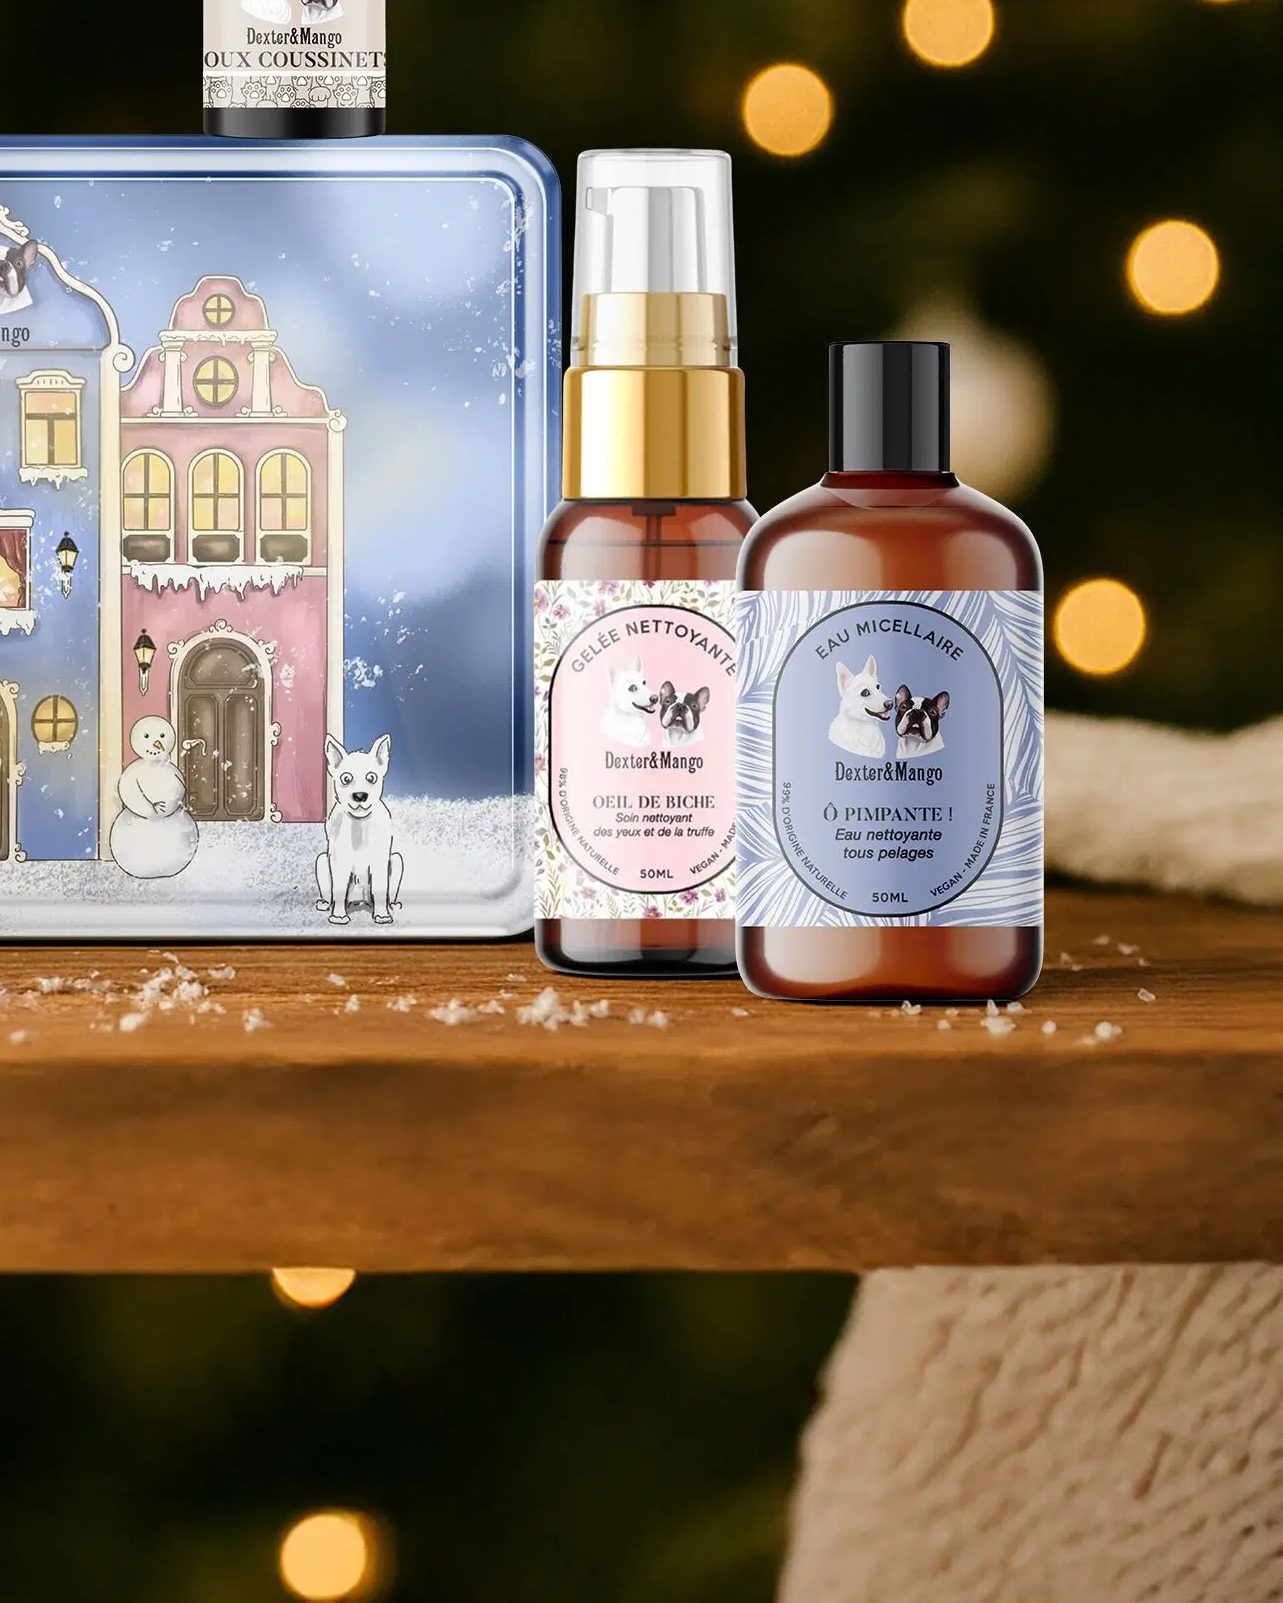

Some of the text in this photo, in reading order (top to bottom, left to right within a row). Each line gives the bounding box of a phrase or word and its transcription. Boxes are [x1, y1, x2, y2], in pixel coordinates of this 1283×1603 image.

[246, 27, 342, 48] Dexter&Mango
[204, 51, 386, 68] OUX COUSSINET
[571, 619, 736, 676] GELÉE NETTOYANTE
[815, 618, 964, 661] EAU MICELLAIRE
[605, 751, 704, 774] Dexter&Mango
[835, 761, 943, 786] Dexter&Mango
[638, 795, 661, 809] DE
[666, 795, 715, 809] BICHE
[823, 802, 838, 821] Ô
[845, 807, 943, 821] PIMPANTE
[983, 783, 995, 825] FRANCE
[615, 812, 693, 825] Soin nettoyant
[593, 827, 715, 839] des yeux et de la truffe
[782, 782, 848, 900] 99% D'ORIGINE NATURELLE
[835, 828, 942, 844] Eau nettoyante
[980, 827, 989, 839] IN
[577, 836, 620, 876] NATURELLE
[689, 852, 719, 874] VEGAN
[843, 846, 934, 862] tous pelages
[965, 839, 985, 869] MADE
[640, 869, 674, 879] 50ML
[930, 872, 963, 897] VEGAN
[872, 892, 908, 903] 50ML
